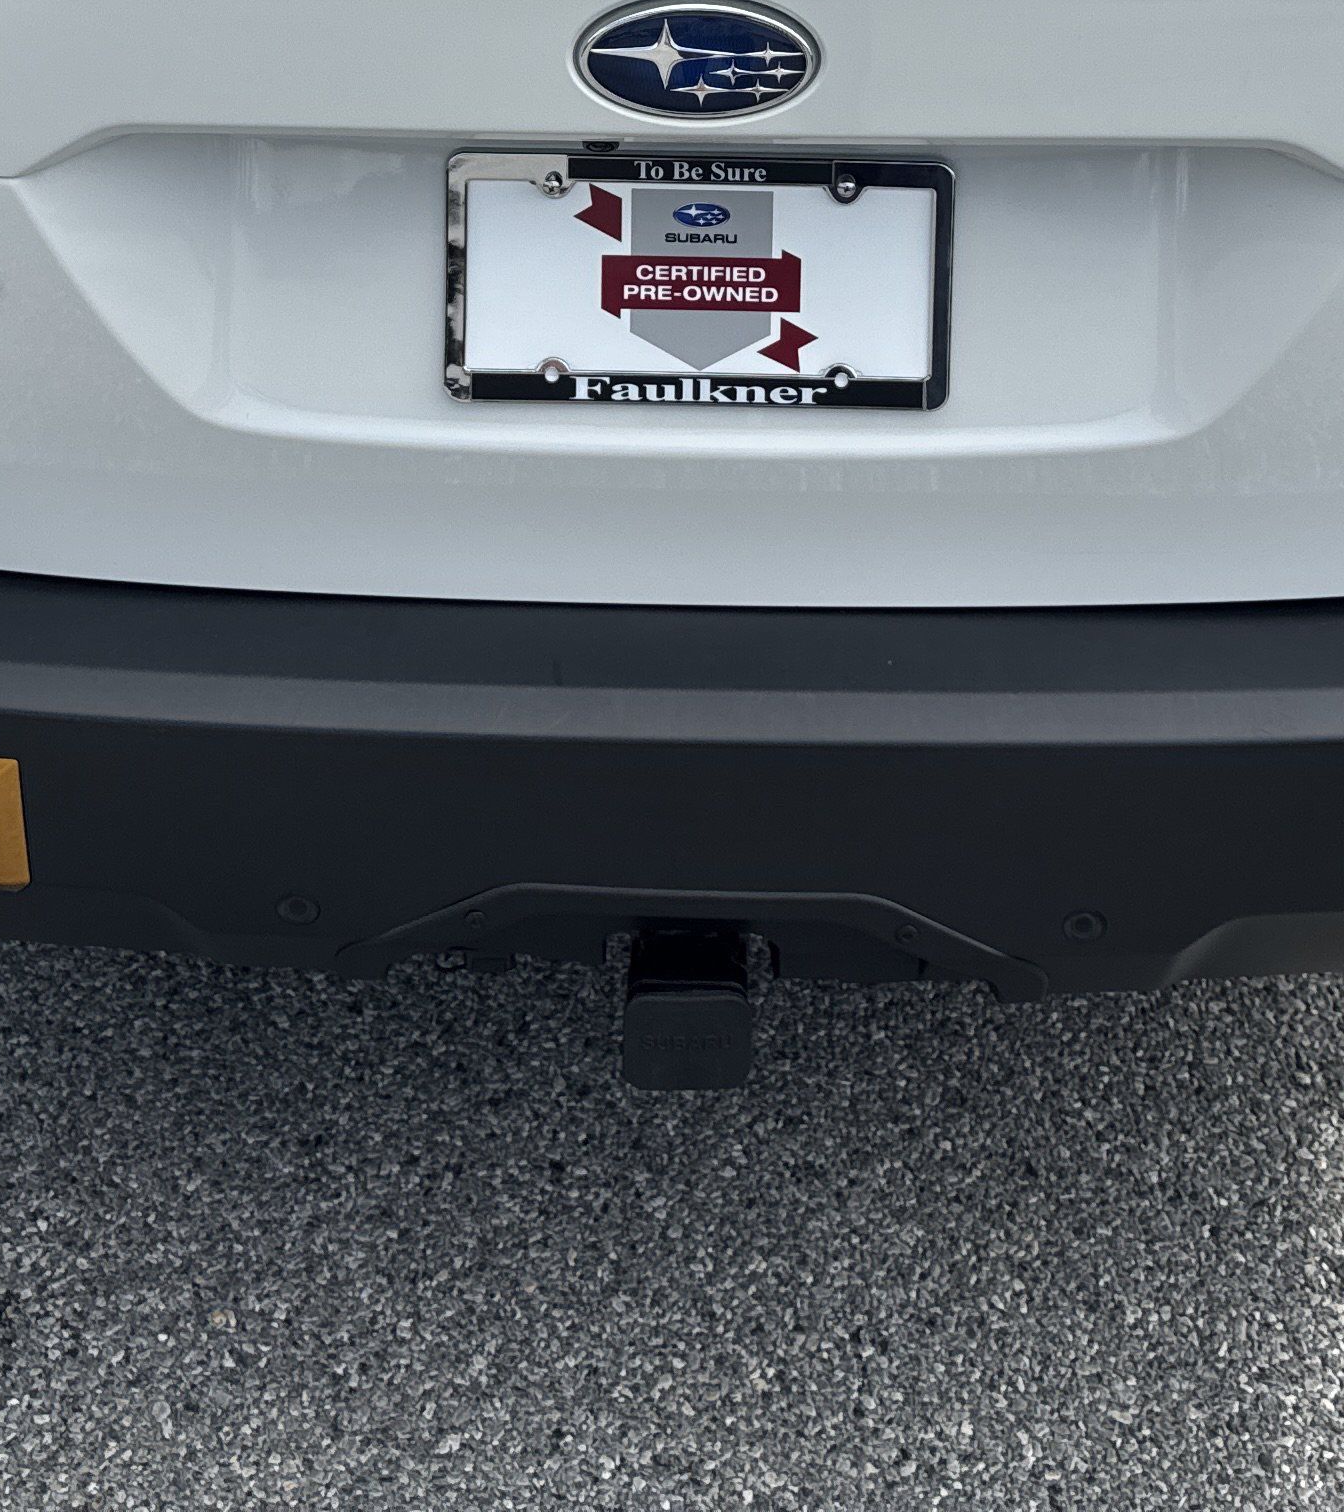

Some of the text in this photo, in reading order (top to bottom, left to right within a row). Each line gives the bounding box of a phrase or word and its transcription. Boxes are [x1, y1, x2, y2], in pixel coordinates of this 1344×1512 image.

[634, 160, 767, 182] To Be Sure
[664, 232, 738, 244] SUBARU
[635, 264, 766, 283] CERTIFIED
[622, 284, 779, 304] PRE-OWNED
[569, 375, 828, 405] Faulkner
